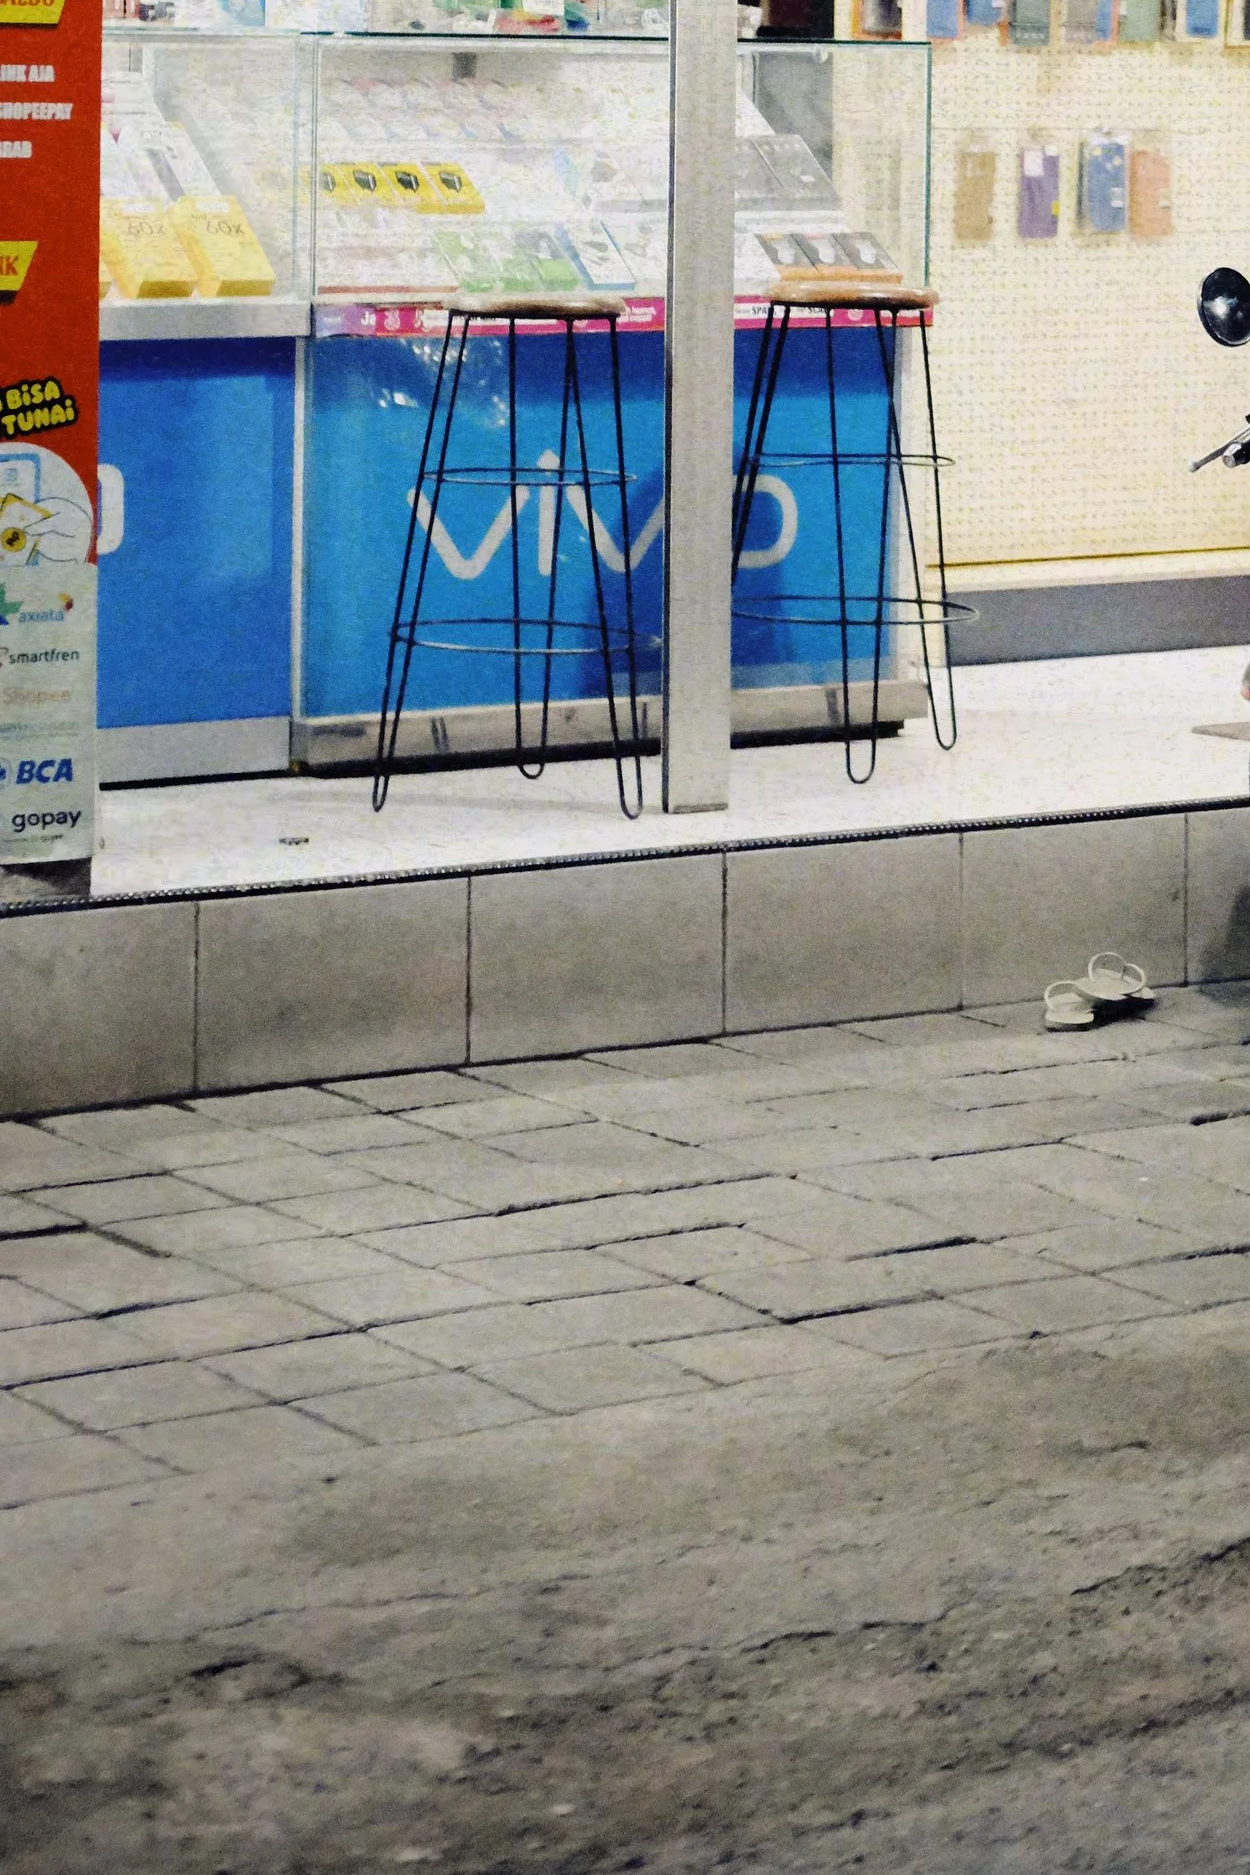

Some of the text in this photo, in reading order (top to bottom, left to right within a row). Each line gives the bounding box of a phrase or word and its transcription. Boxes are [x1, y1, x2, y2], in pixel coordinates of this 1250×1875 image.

[8, 648, 80, 664] smartfren
[15, 758, 74, 785] BCA
[11, 810, 82, 833] gopay
